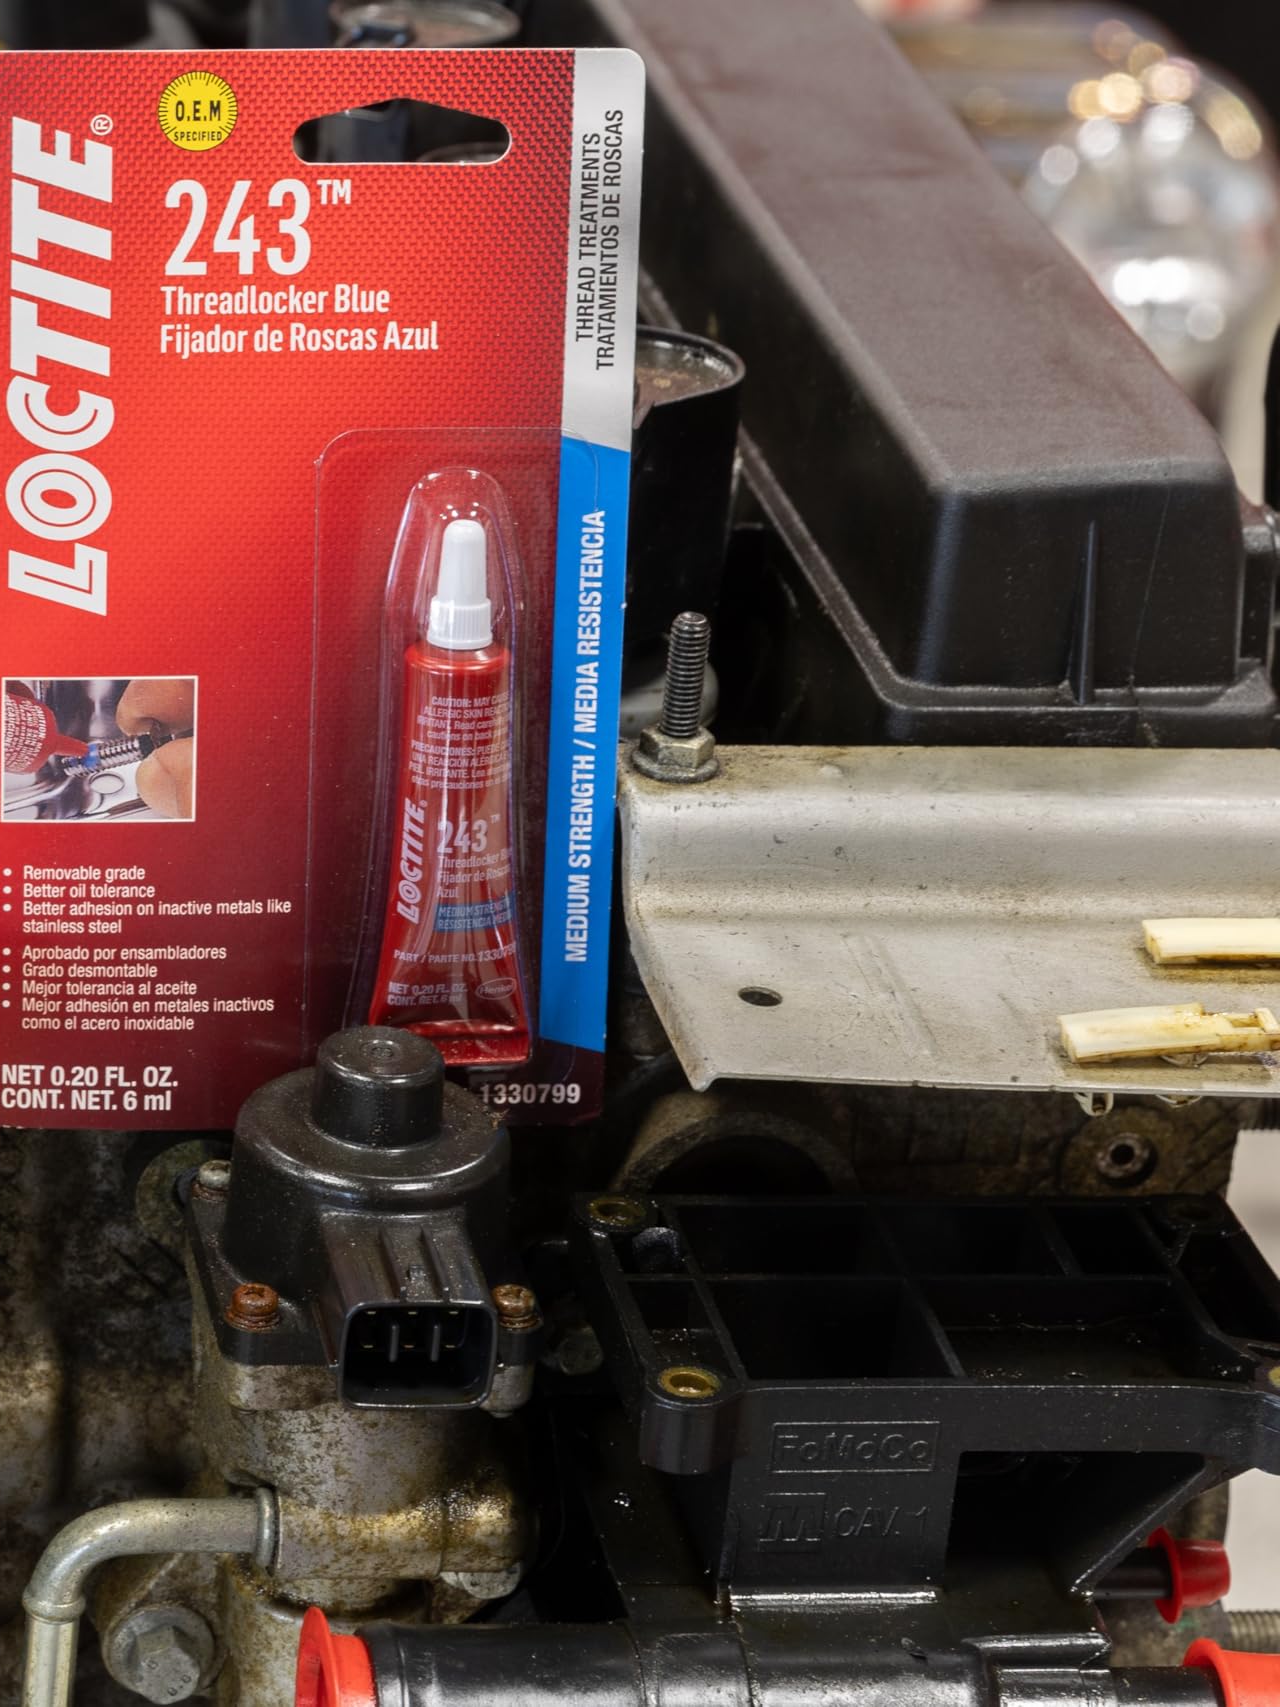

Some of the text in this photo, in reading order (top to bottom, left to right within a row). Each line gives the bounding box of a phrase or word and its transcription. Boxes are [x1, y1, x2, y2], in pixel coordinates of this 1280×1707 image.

[175, 100, 221, 122] O.E.M
[174, 131, 222, 143] SPECIFIED
[576, 132, 600, 342] THREAD TREATMENTS
[596, 109, 623, 370] TRATAMIENTOS DE ROSCAS
[160, 284, 390, 315] Threadlocker Blue
[160, 321, 438, 359] Fijador de Roscas Azul
[577, 510, 606, 656] RESISTENCIA
[573, 661, 599, 734] MEDIA
[568, 754, 596, 869] STRENGTH
[438, 853, 499, 868] Threadlocker
[23, 865, 146, 883] Removable grade
[438, 871, 472, 885] Fijador
[473, 870, 485, 881] de
[23, 884, 156, 899] Better oil tolerance
[437, 886, 459, 898] Azul
[23, 899, 292, 916] Better adhesion on inactive metals like
[23, 919, 122, 934] stainless steel
[565, 875, 591, 963] MEDIUM
[22, 945, 227, 963] Aprobado por ensambladores
[394, 949, 419, 962] PART
[22, 963, 158, 978] Grado desmontable
[22, 980, 198, 997] Mejor tolerancia al aceite
[388, 981, 409, 994] NET
[22, 996, 275, 1015] Mejor adhesión en metales inactivos
[22, 1016, 195, 1031] como el acero inoxidable
[1, 1064, 179, 1088] NET 0.20 FL. OZ.
[1, 1088, 172, 1111] CONT. NET. 6 ml
[480, 1083, 581, 1104] 1330799
[777, 1433, 929, 1461] FoMoCo
